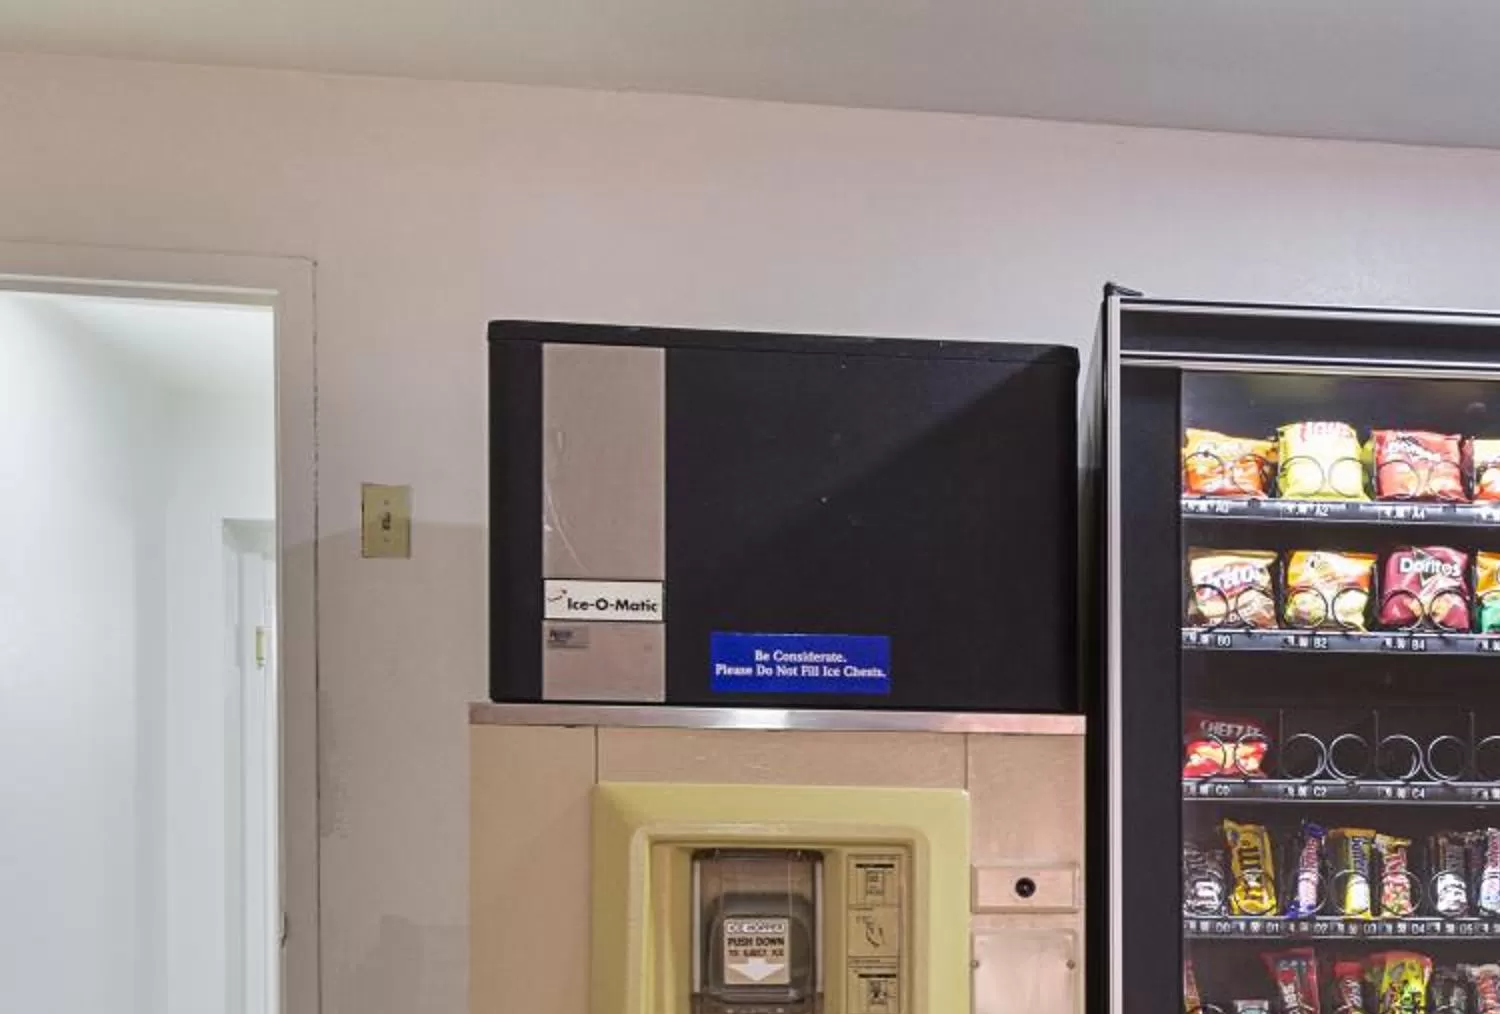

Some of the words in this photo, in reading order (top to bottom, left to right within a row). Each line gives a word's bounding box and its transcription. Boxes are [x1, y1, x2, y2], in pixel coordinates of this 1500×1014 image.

[1399, 557, 1461, 578] Doritos
[567, 597, 658, 613] Ice-O-Matic
[755, 650, 770, 662] Be
[773, 651, 848, 663] Considerate.
[715, 664, 753, 676] Please
[756, 665, 773, 677] Do
[776, 666, 799, 677] Not
[801, 666, 820, 677] Fill
[823, 666, 841, 678] Ice
[728, 937, 753, 947] PUSH
[755, 937, 785, 947] DOWN
